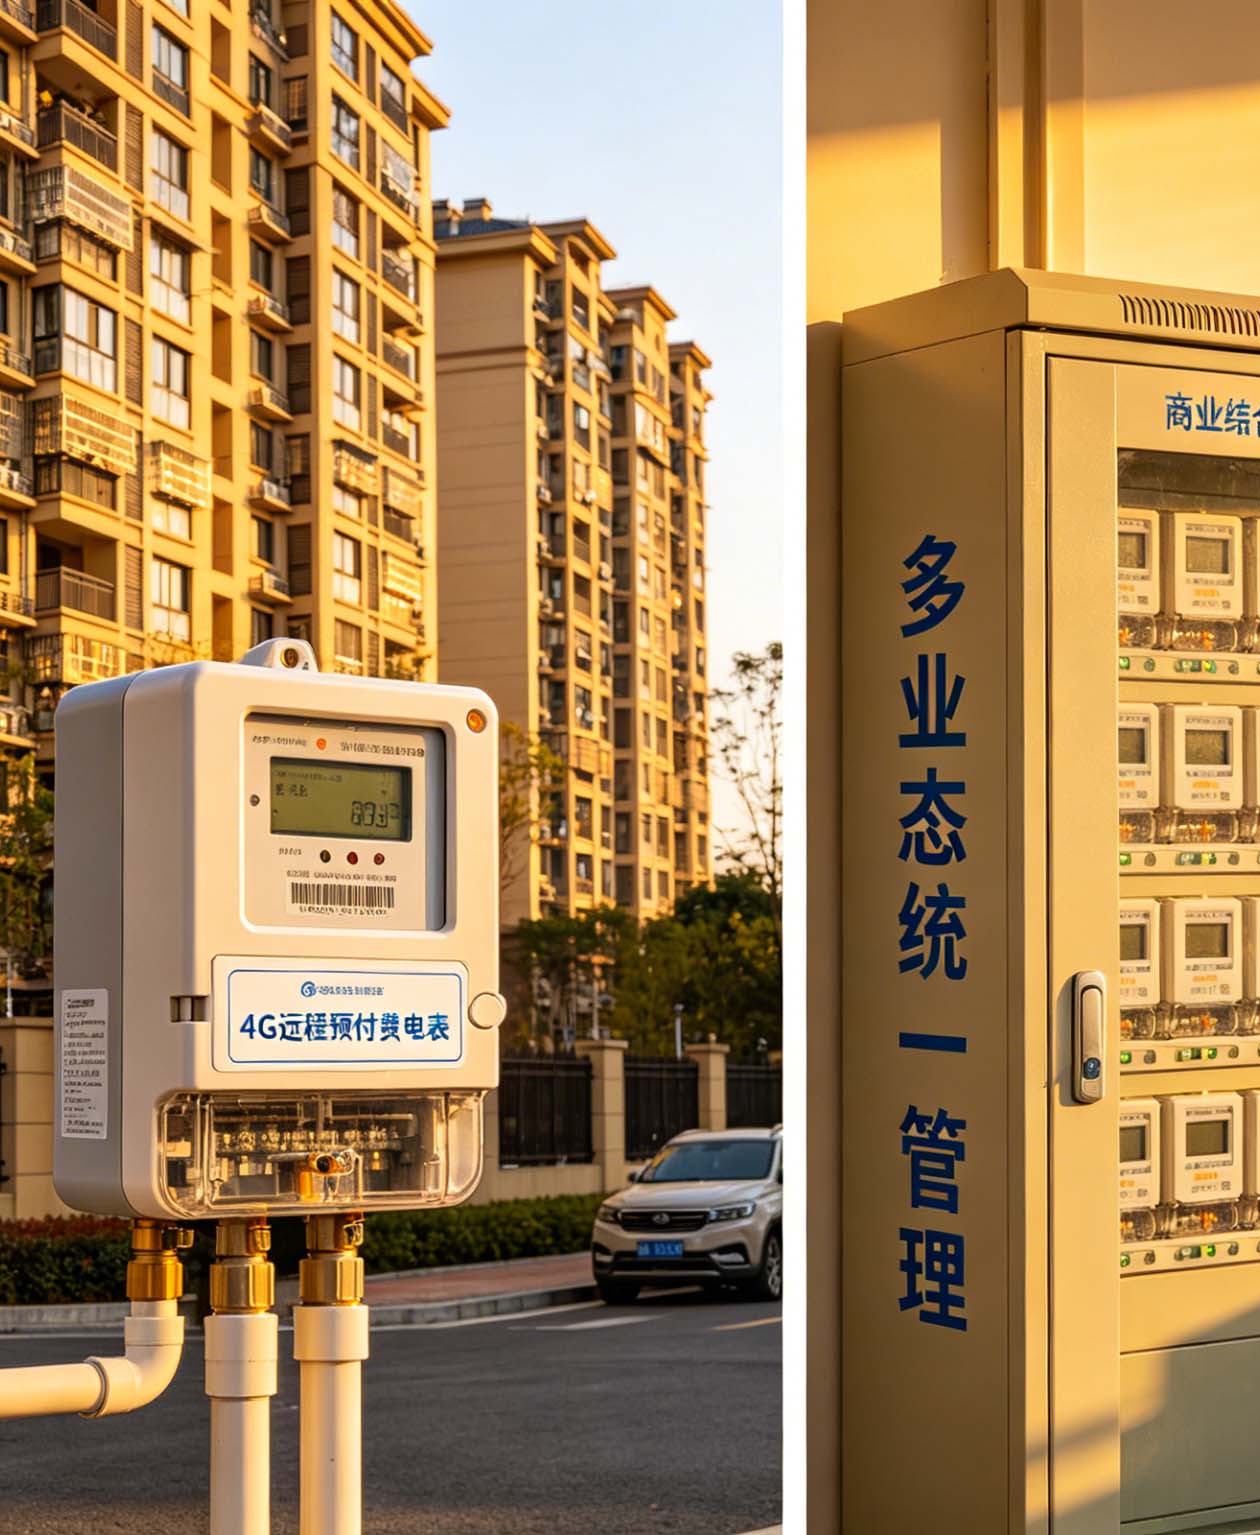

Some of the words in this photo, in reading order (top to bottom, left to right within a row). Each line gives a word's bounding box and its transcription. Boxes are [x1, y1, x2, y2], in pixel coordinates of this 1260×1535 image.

[897, 534, 968, 1332] 多业态统一管理
